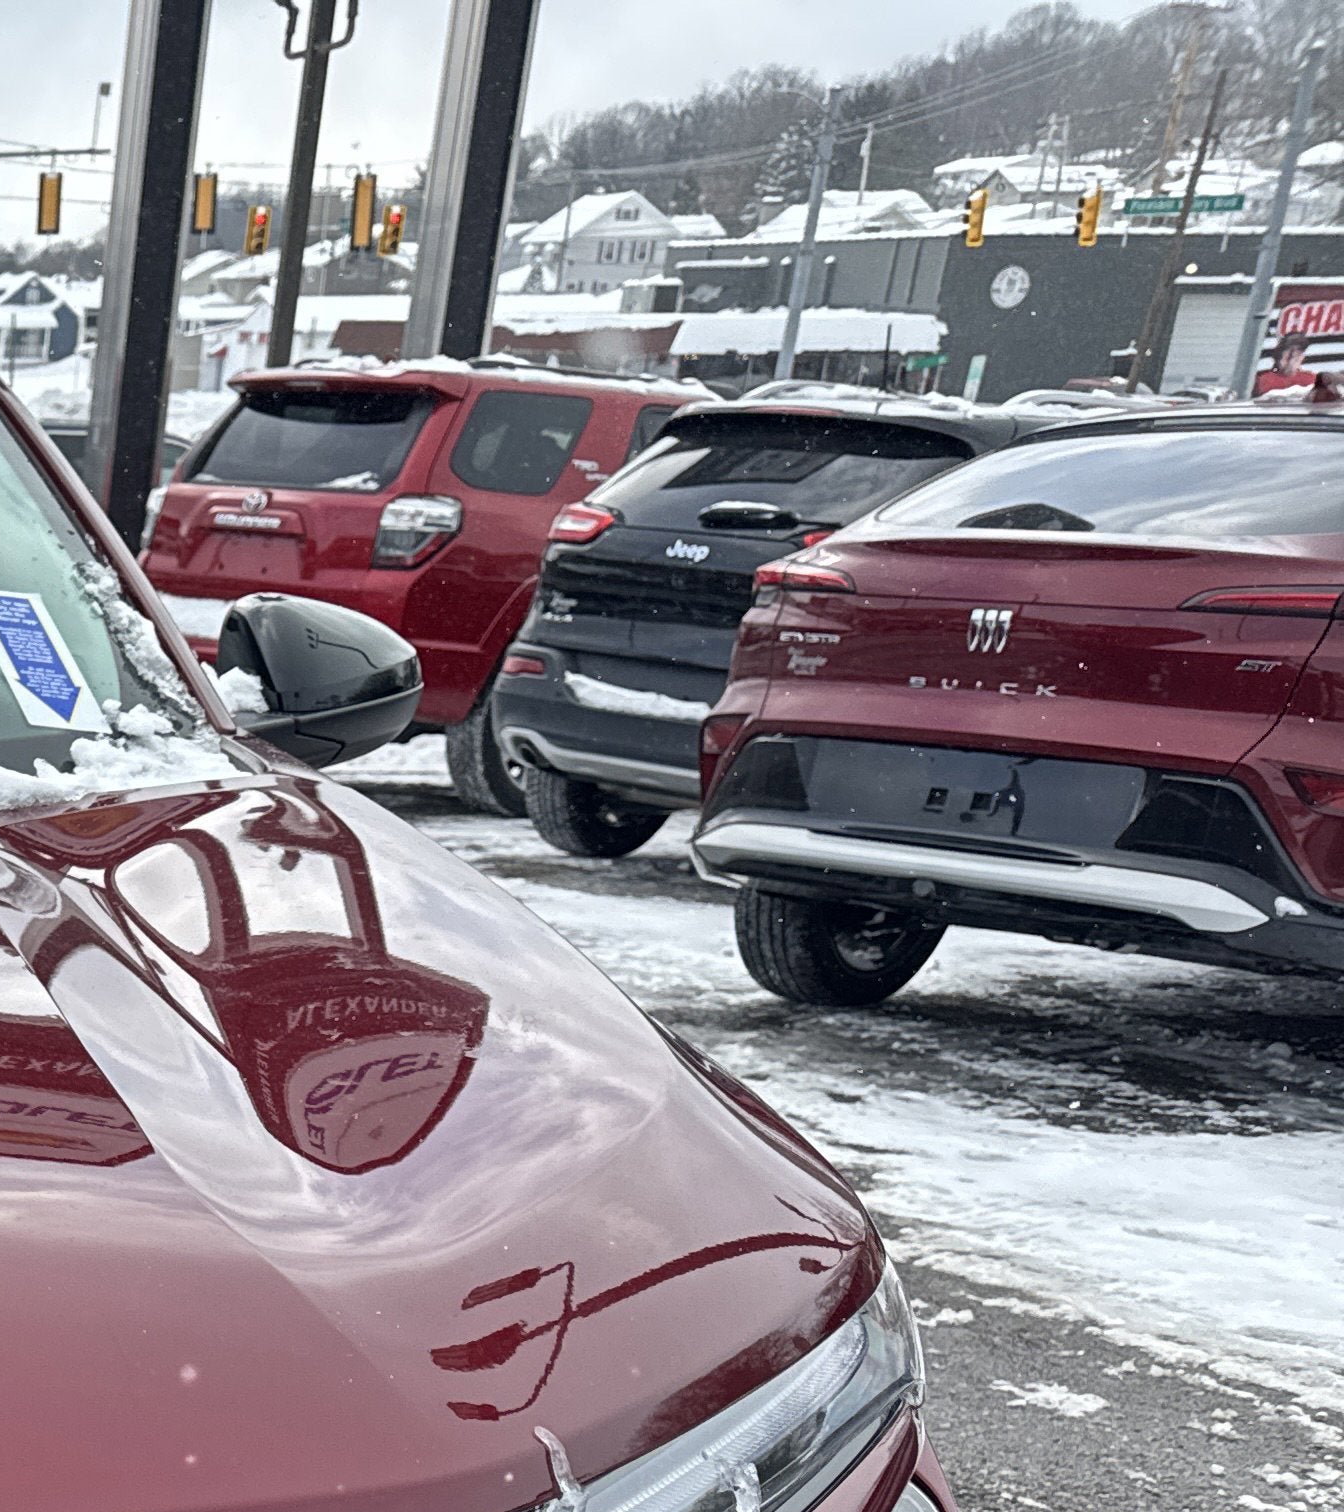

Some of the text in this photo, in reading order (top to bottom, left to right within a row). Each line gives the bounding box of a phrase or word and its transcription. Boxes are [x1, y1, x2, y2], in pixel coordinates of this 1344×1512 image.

[665, 538, 711, 563] Jeep
[1235, 659, 1283, 673] ST
[908, 675, 1058, 698] BUICK
